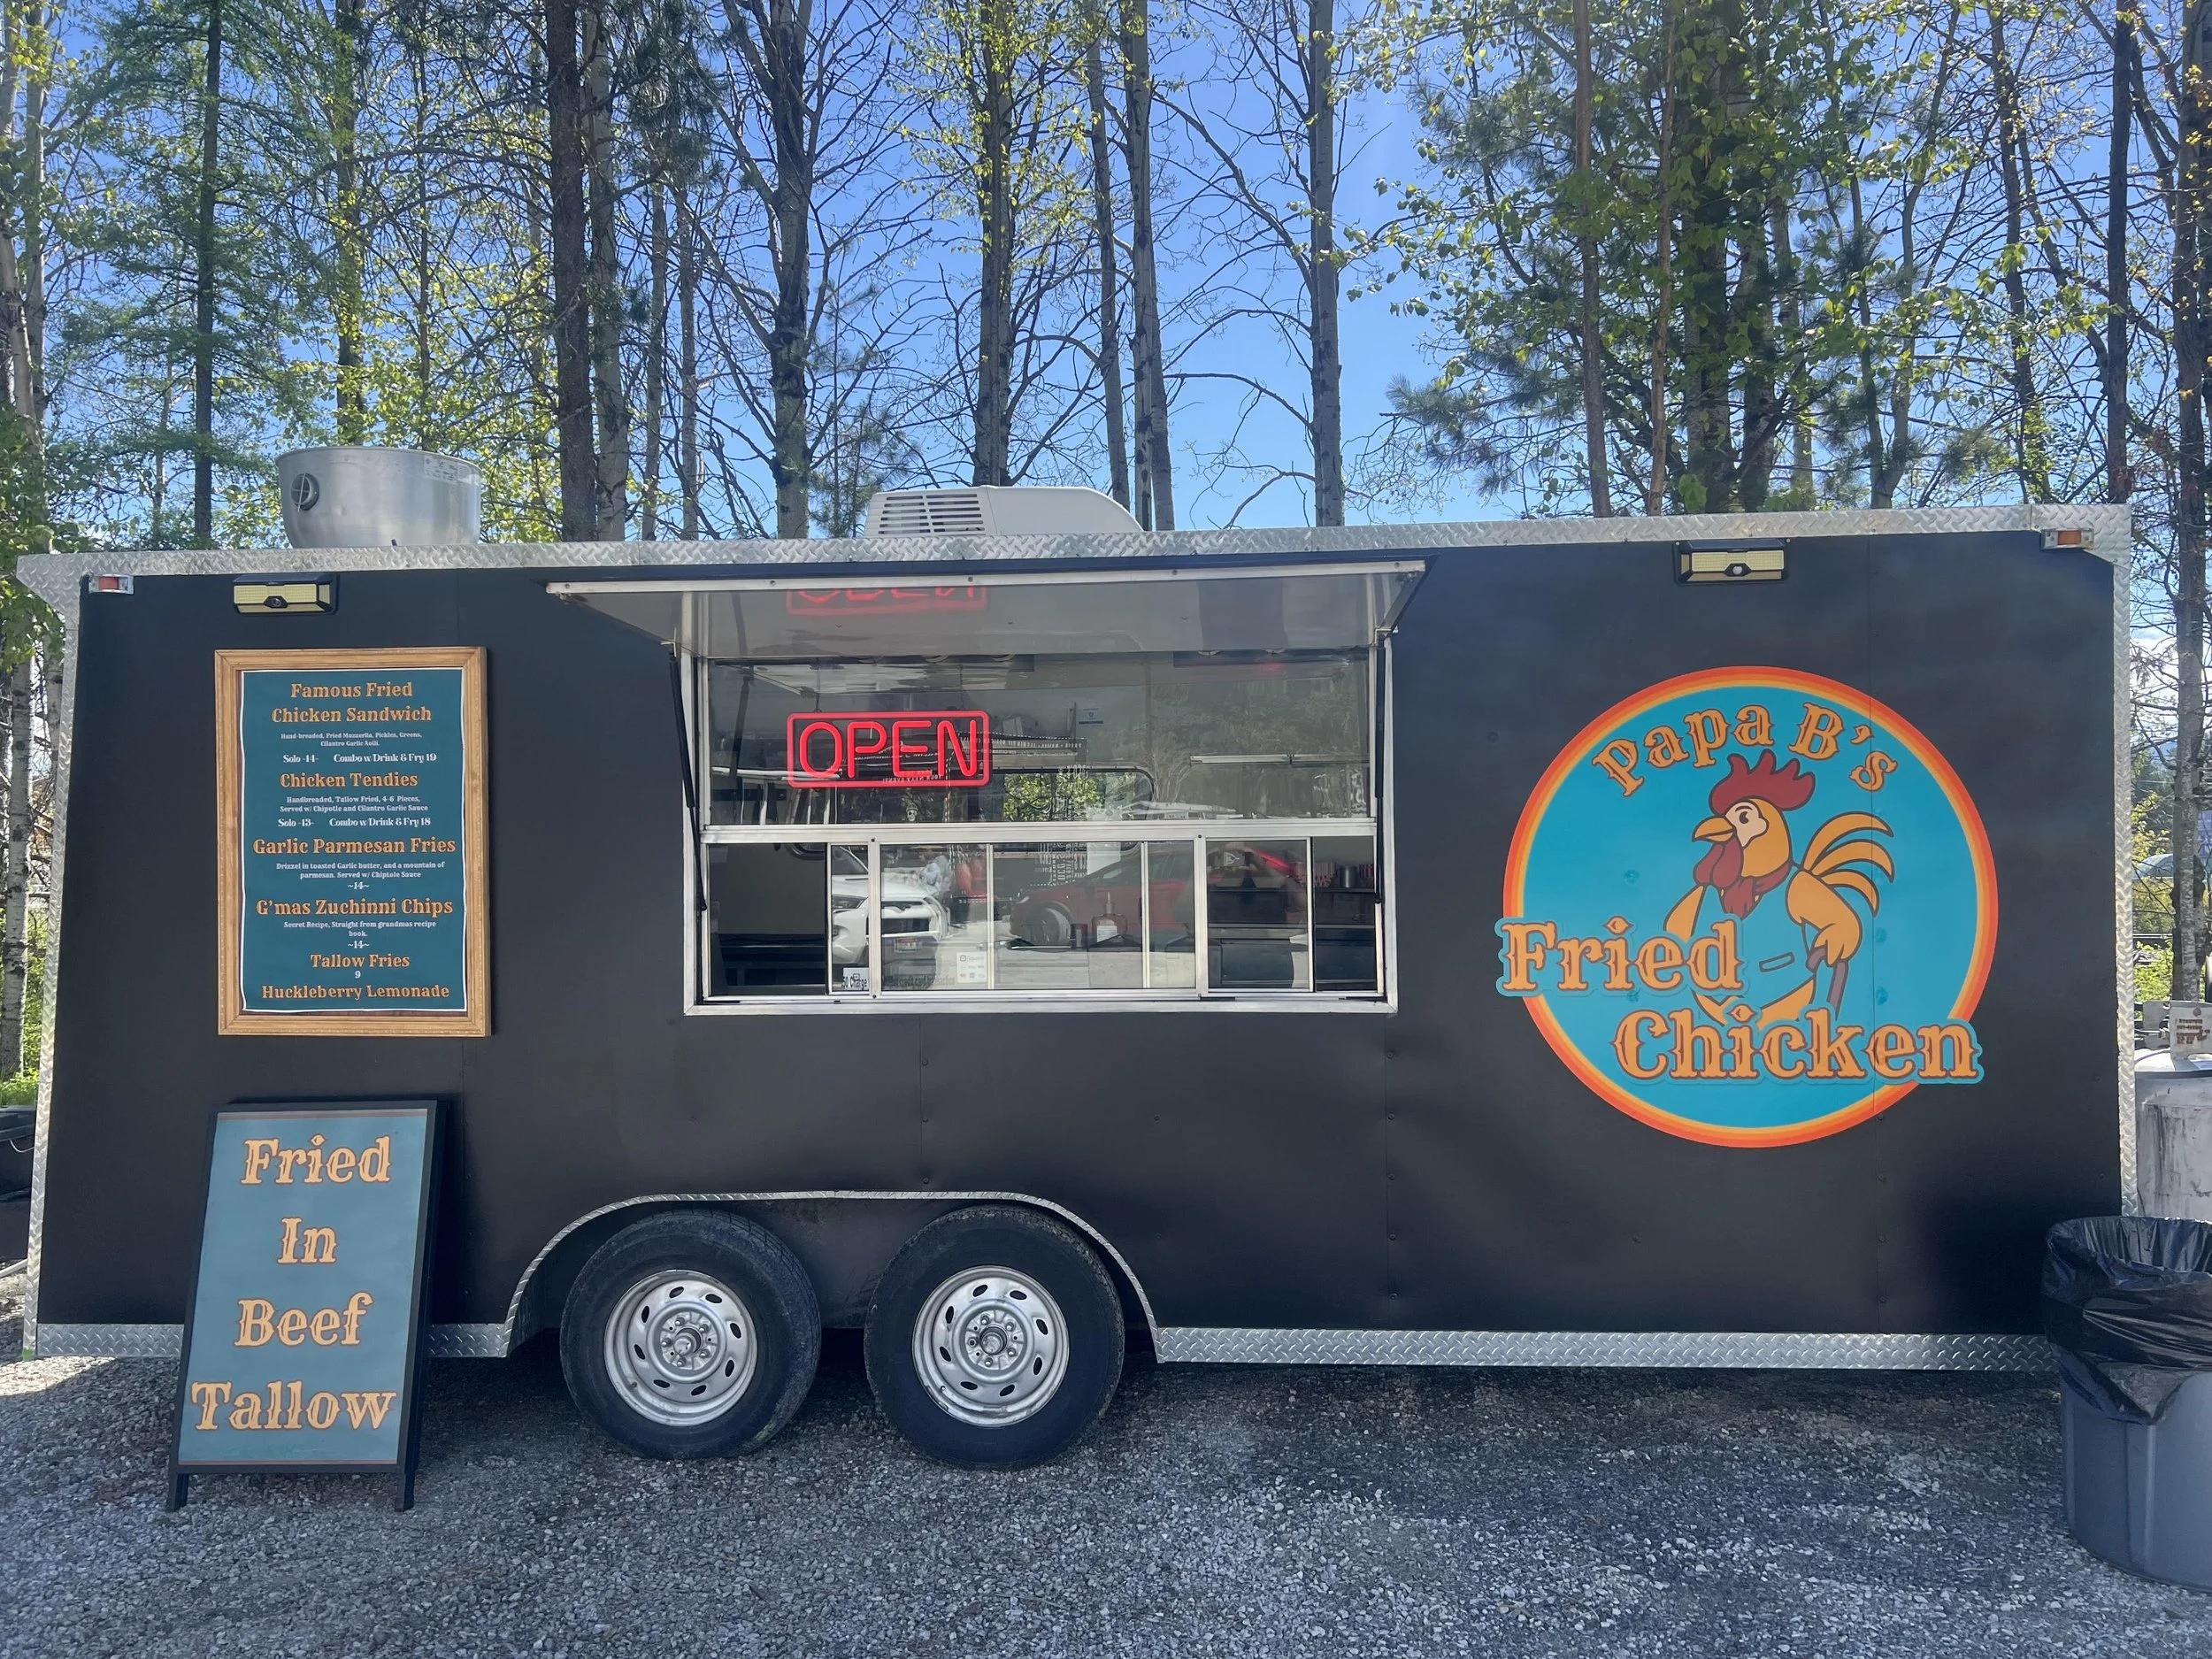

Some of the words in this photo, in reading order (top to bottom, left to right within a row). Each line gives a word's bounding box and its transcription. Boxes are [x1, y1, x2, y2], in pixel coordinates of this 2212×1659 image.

[289, 683, 362, 698] Famous
[365, 680, 413, 697] Fried
[271, 706, 342, 723] Chicken
[346, 705, 432, 722] Sandwich
[333, 753, 363, 764] Combo
[372, 752, 399, 763] Drink
[400, 753, 408, 762] &
[408, 752, 426, 764] Fry
[426, 752, 438, 762] 19
[799, 719, 978, 779] OPEN
[1593, 703, 1775, 796] Papa
[1788, 702, 1898, 792] B's
[282, 754, 302, 764] Solo
[280, 772, 347, 788] Chicken
[349, 771, 419, 787] Tendies
[396, 795, 421, 803] Pieces,
[312, 804, 342, 813] Chipotle
[277, 818, 297, 827] Solo
[328, 818, 358, 827] Combo
[368, 817, 395, 826] Drink
[395, 817, 403, 826] &
[403, 817, 420, 828] Fry
[420, 817, 432, 826] 18
[252, 837, 309, 855] Garlic
[312, 838, 406, 854] Parmesan
[409, 835, 457, 854] Fries
[314, 897, 397, 915] Zuchinni
[400, 896, 454, 918] Chips
[331, 920, 359, 929] Straight
[377, 920, 413, 929] grandmas
[413, 920, 437, 929] recipe
[310, 953, 365, 968] Tallow
[368, 952, 411, 968] Fries
[1500, 915, 1742, 992] Fried
[354, 970, 362, 979] 9
[261, 984, 363, 1001] Huckleberry
[365, 984, 450, 998] Lemonade
[1613, 1003, 1978, 1080] Chicken
[240, 1133, 391, 1185] Fried
[277, 1217, 339, 1264] In
[234, 1291, 375, 1348] Beef
[190, 1379, 398, 1432] Tallow
